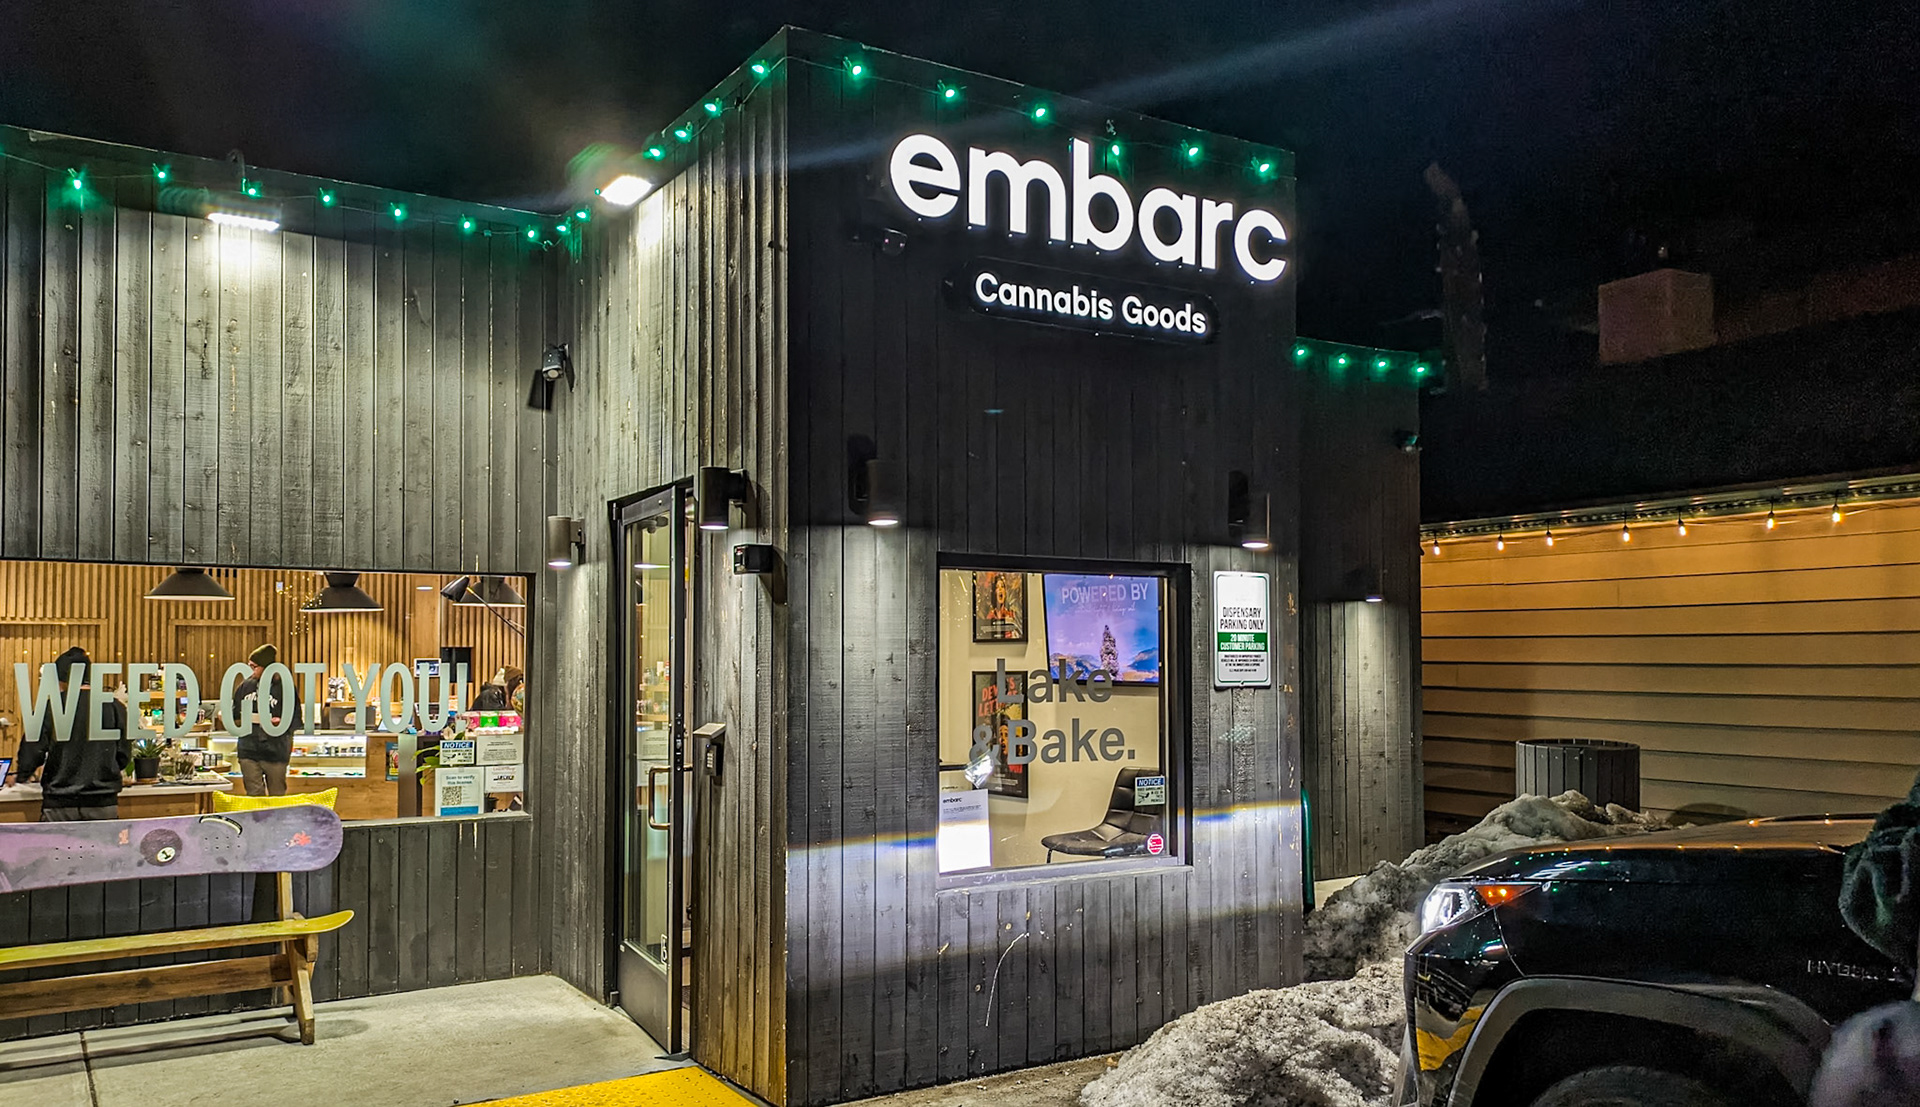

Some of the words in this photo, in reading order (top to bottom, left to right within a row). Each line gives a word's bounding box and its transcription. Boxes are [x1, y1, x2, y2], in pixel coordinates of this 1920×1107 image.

[889, 134, 1288, 282] embarc
[975, 272, 1114, 320] Cannabis
[1122, 295, 1207, 334] Goods
[1061, 584, 1127, 604] POWERED
[1130, 583, 1149, 600] BY
[1223, 606, 1262, 618] DISPENSARY
[1220, 618, 1247, 630] PARKING
[1248, 619, 1265, 630] ONLY
[996, 658, 1113, 703] Lake
[14, 662, 200, 742] WEED
[220, 662, 327, 738] GOT
[342, 662, 468, 734] YOU!
[443, 741, 470, 749] NOTICE
[1138, 778, 1162, 787] NOTICE
